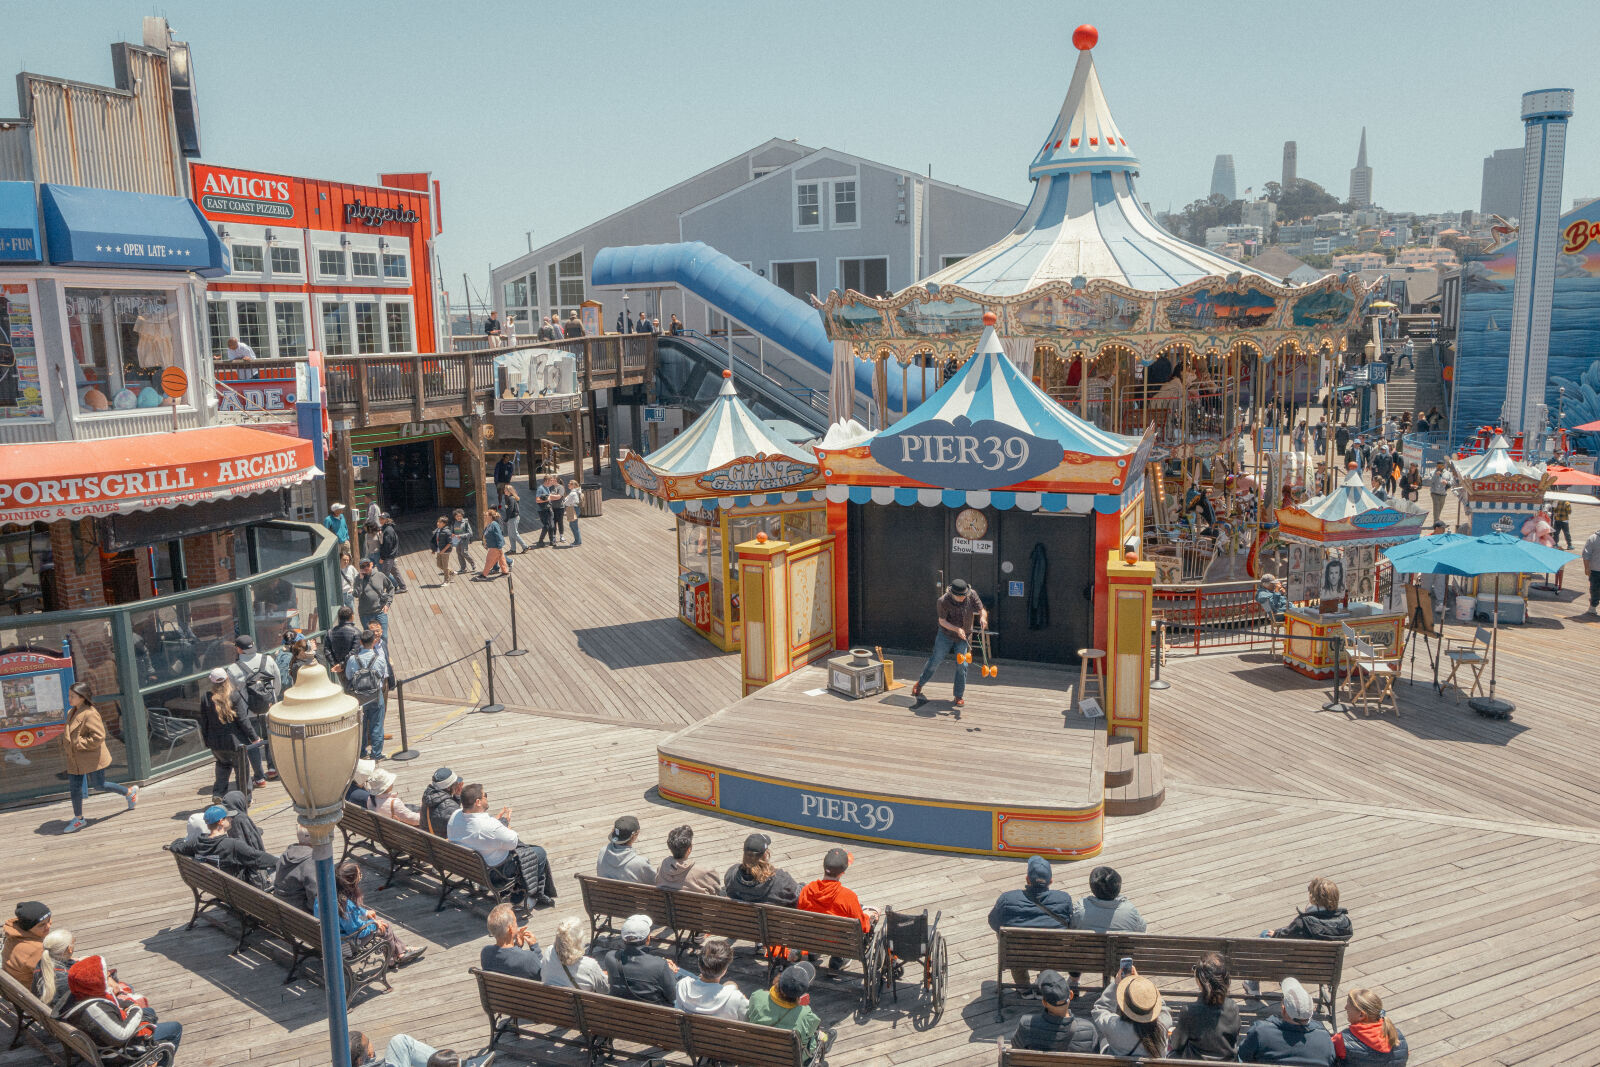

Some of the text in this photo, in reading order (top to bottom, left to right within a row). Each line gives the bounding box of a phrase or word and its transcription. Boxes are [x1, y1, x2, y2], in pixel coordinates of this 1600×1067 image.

[202, 172, 290, 201] AMICI'S
[207, 198, 291, 215] EAST COAST PIZZERIA
[344, 199, 419, 227] pizzeria
[11, 237, 33, 251] FUN
[124, 243, 167, 257] OPEN LATE
[217, 450, 298, 483] ARCADE
[729, 461, 791, 482] GIANT
[712, 474, 805, 491] CLAW GAME
[1472, 481, 1540, 493] CHURROS
[143, 491, 213, 508] LIVE SPORTS
[0, 502, 120, 522] DINING & GAMES
[953, 545, 972, 553] Show
